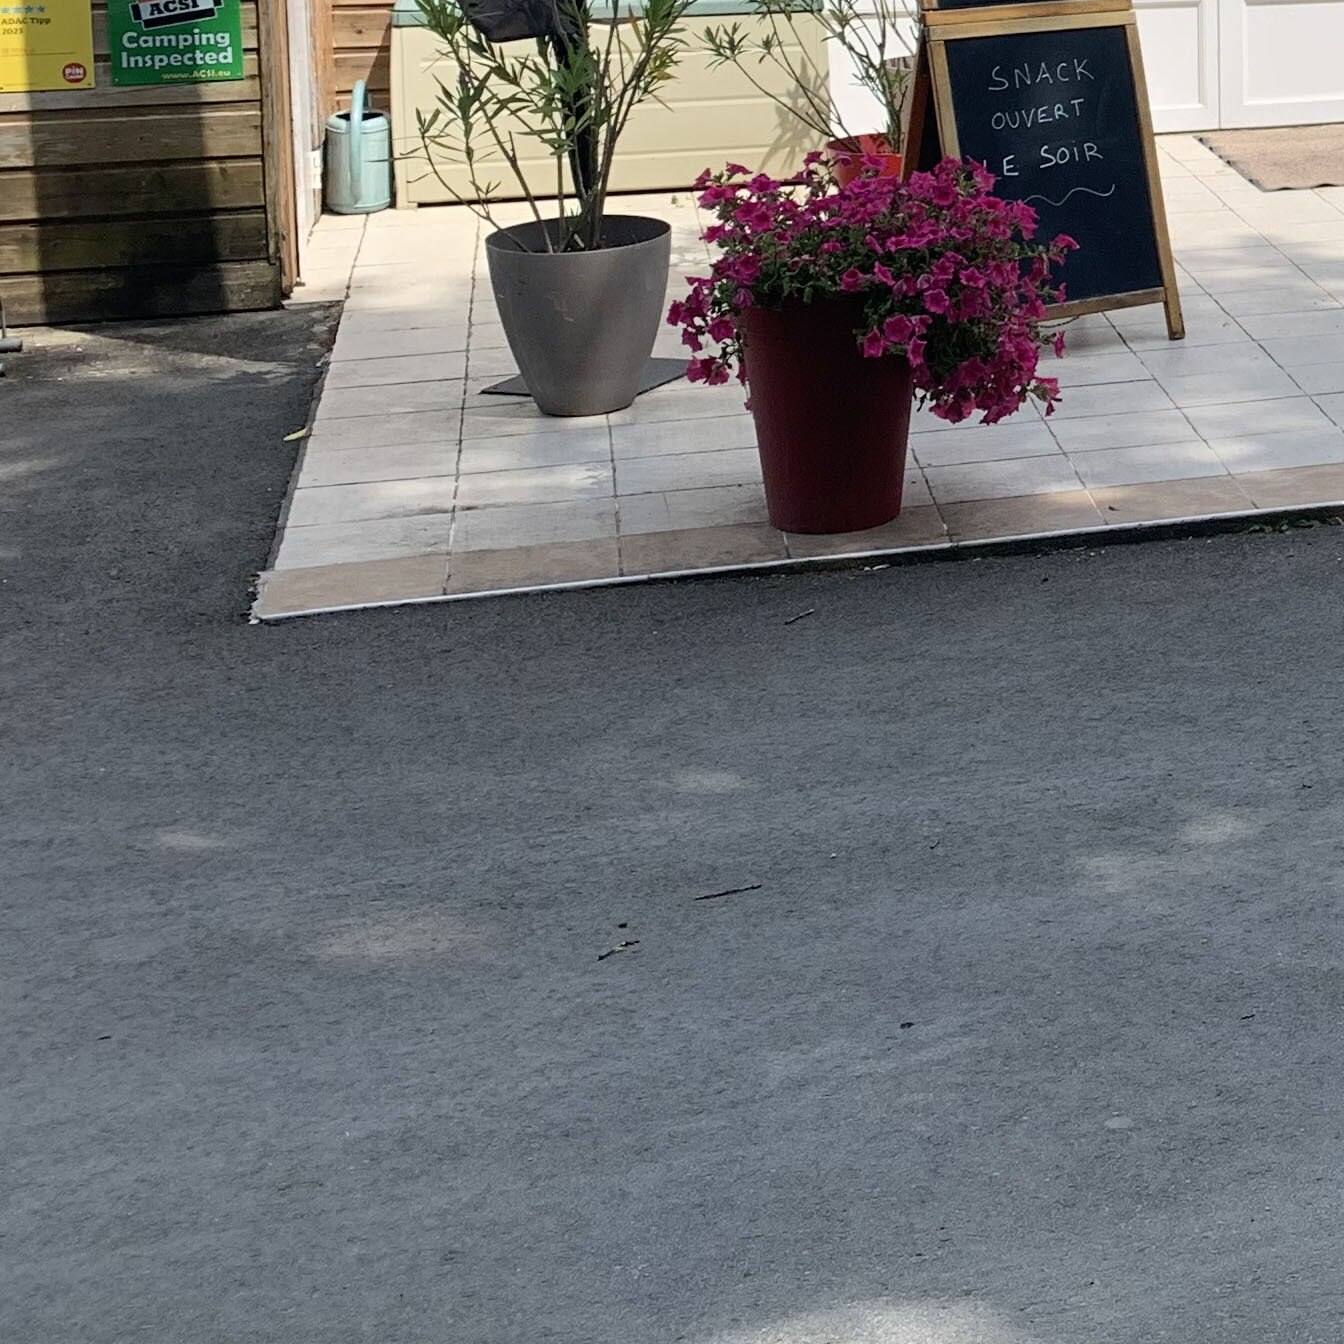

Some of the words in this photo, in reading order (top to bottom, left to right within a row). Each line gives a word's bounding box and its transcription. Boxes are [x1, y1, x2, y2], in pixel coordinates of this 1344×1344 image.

[1, 17, 28, 25] ADAC
[30, 17, 50, 26] Tipp
[122, 29, 230, 50] Camping
[121, 47, 233, 70] Inspected
[162, 69, 231, 79] www.ACSI.eu
[988, 58, 1095, 91] SNACK
[992, 98, 1085, 130] OUVERT
